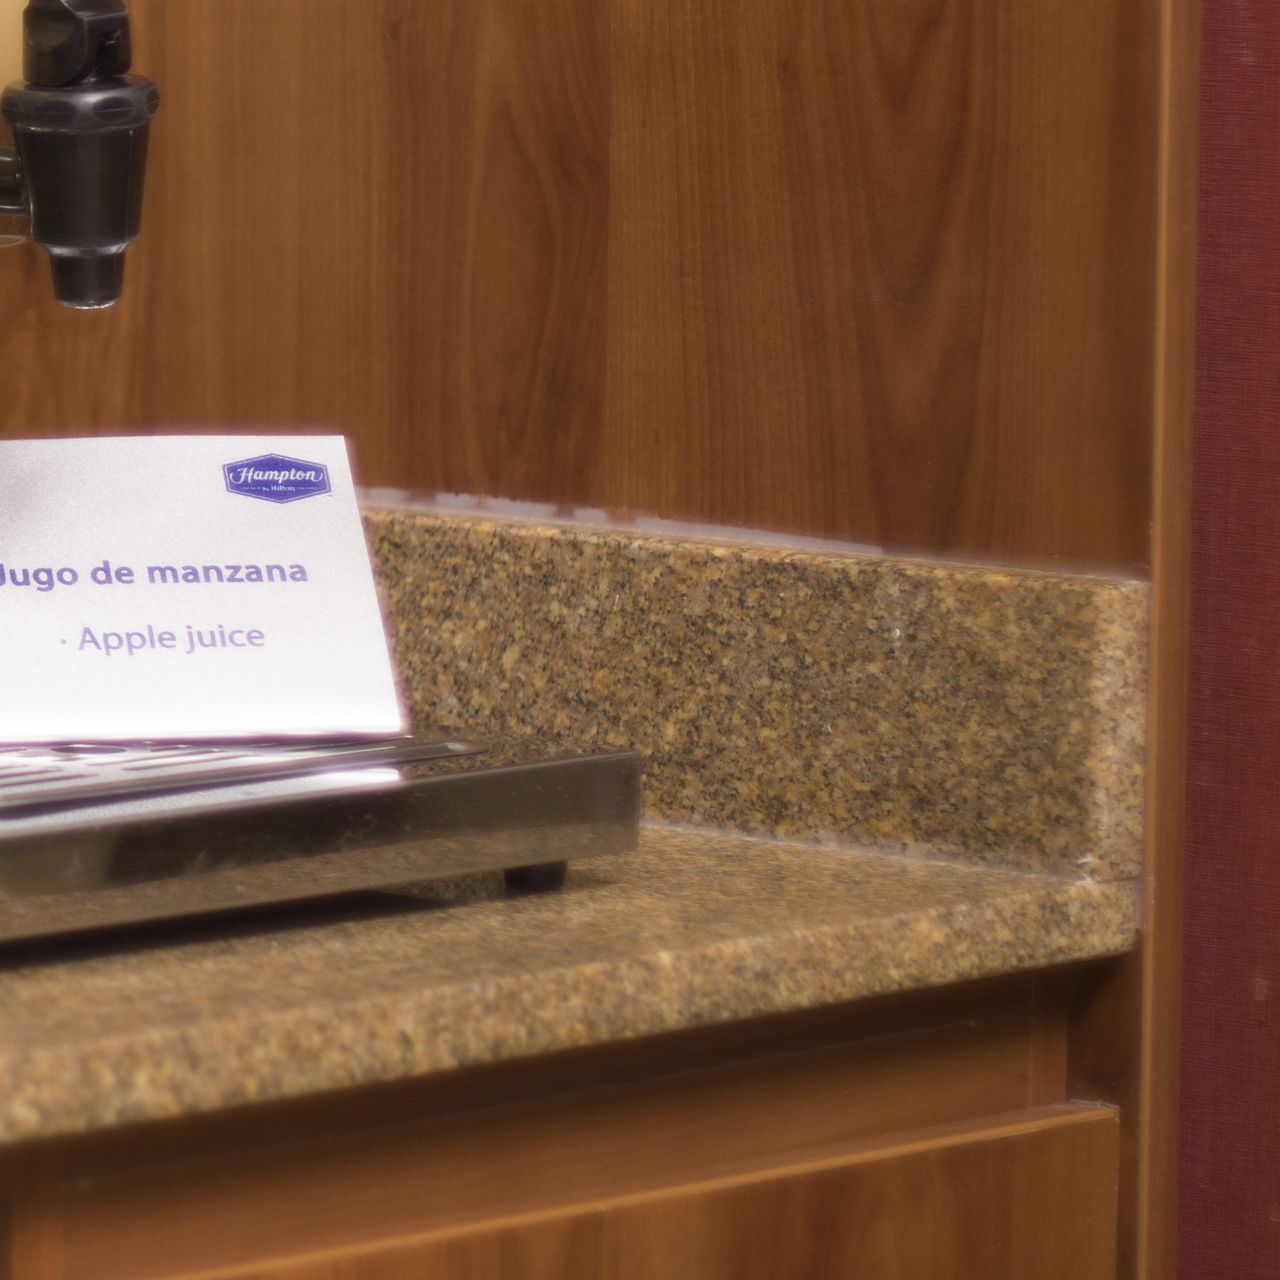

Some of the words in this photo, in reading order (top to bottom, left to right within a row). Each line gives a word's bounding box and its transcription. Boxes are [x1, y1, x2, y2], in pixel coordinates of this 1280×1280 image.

[230, 466, 323, 484] Hampton
[90, 560, 135, 585] de
[146, 563, 309, 584] manzana
[78, 625, 177, 656] Apple
[184, 624, 266, 655] juice
